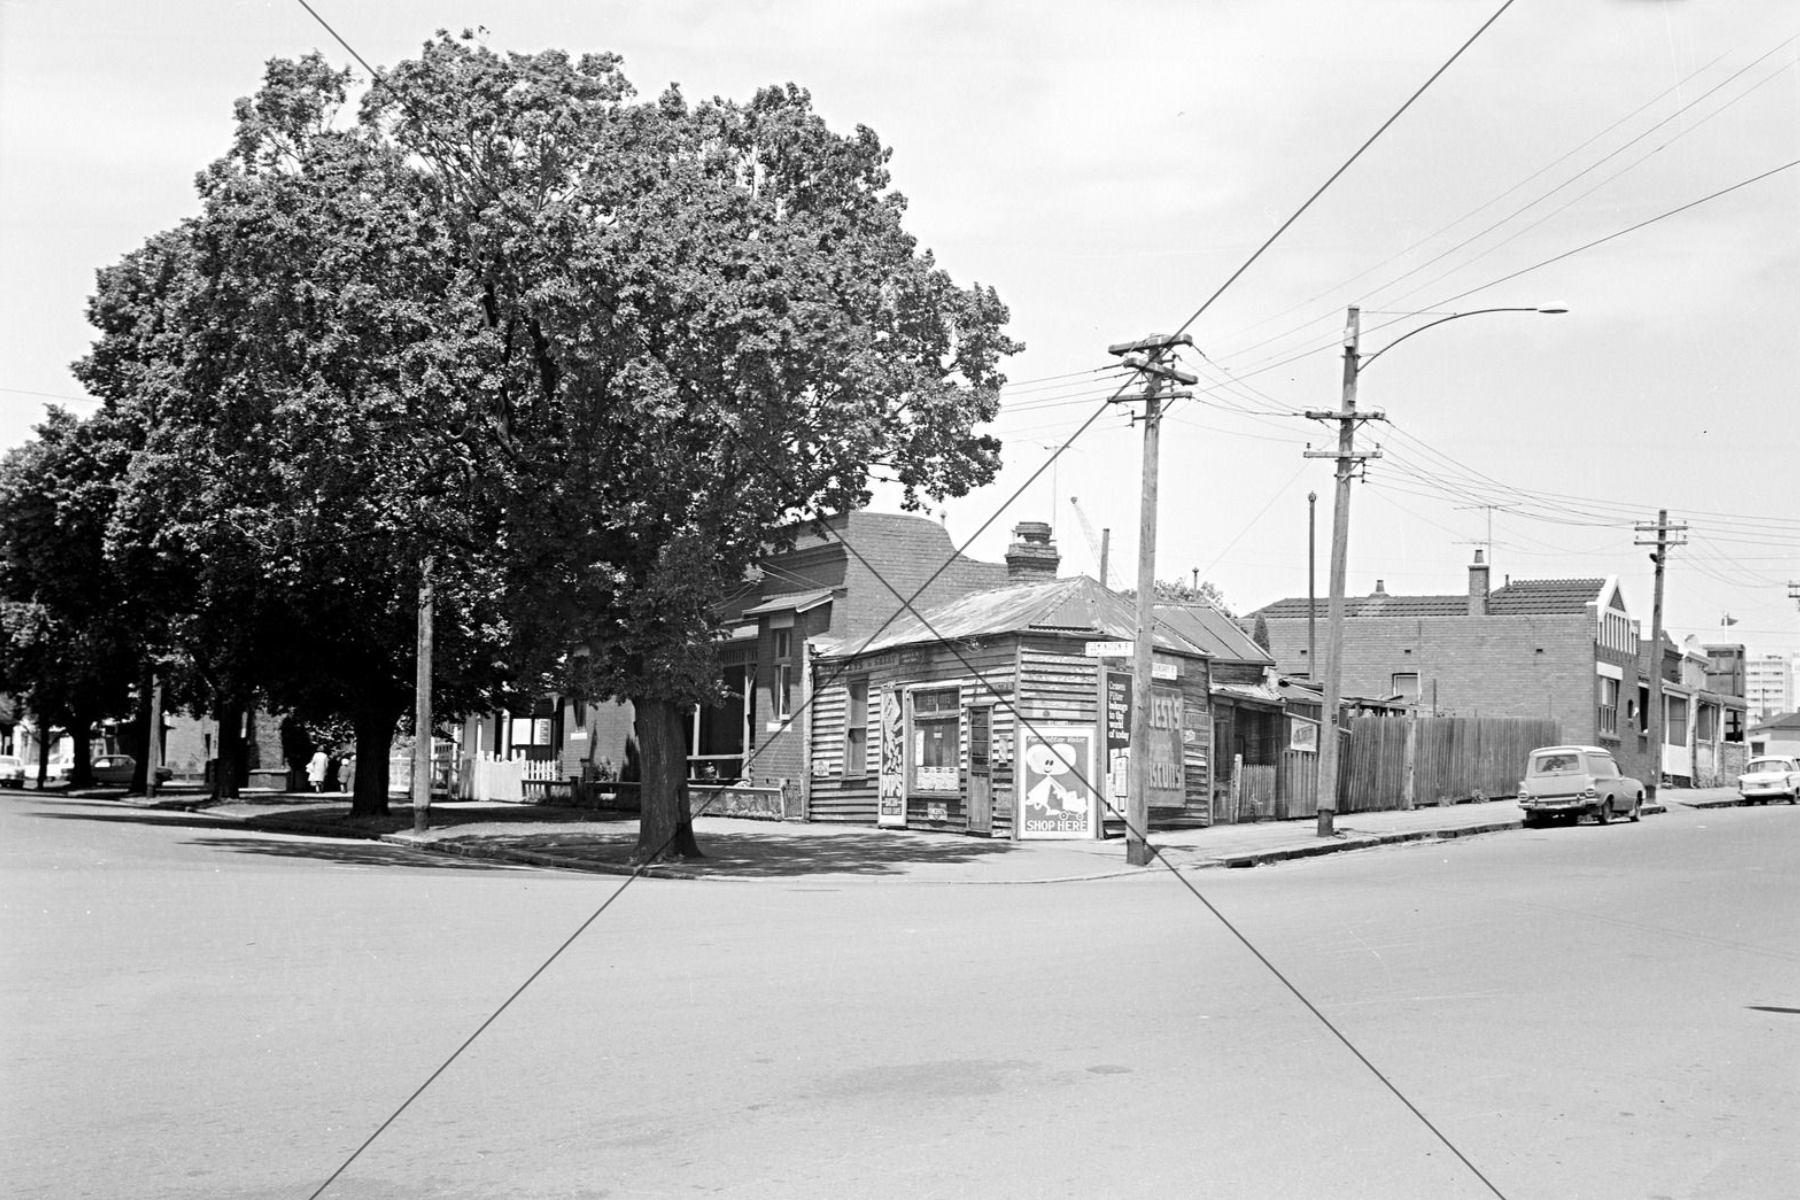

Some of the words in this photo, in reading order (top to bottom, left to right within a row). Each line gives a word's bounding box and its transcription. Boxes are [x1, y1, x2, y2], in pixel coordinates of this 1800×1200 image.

[1108, 681, 1126, 691] Craven
[1108, 691, 1124, 701] Filter
[1108, 701, 1129, 713] belongs
[1108, 711, 1115, 720] to
[1116, 711, 1124, 720] the
[1108, 720, 1124, 728] world
[1108, 729, 1115, 738] of
[1115, 729, 1130, 741] today
[1149, 761, 1182, 790] ISCUITS
[1026, 820, 1055, 831] SHOP
[1057, 820, 1087, 831] HERE
